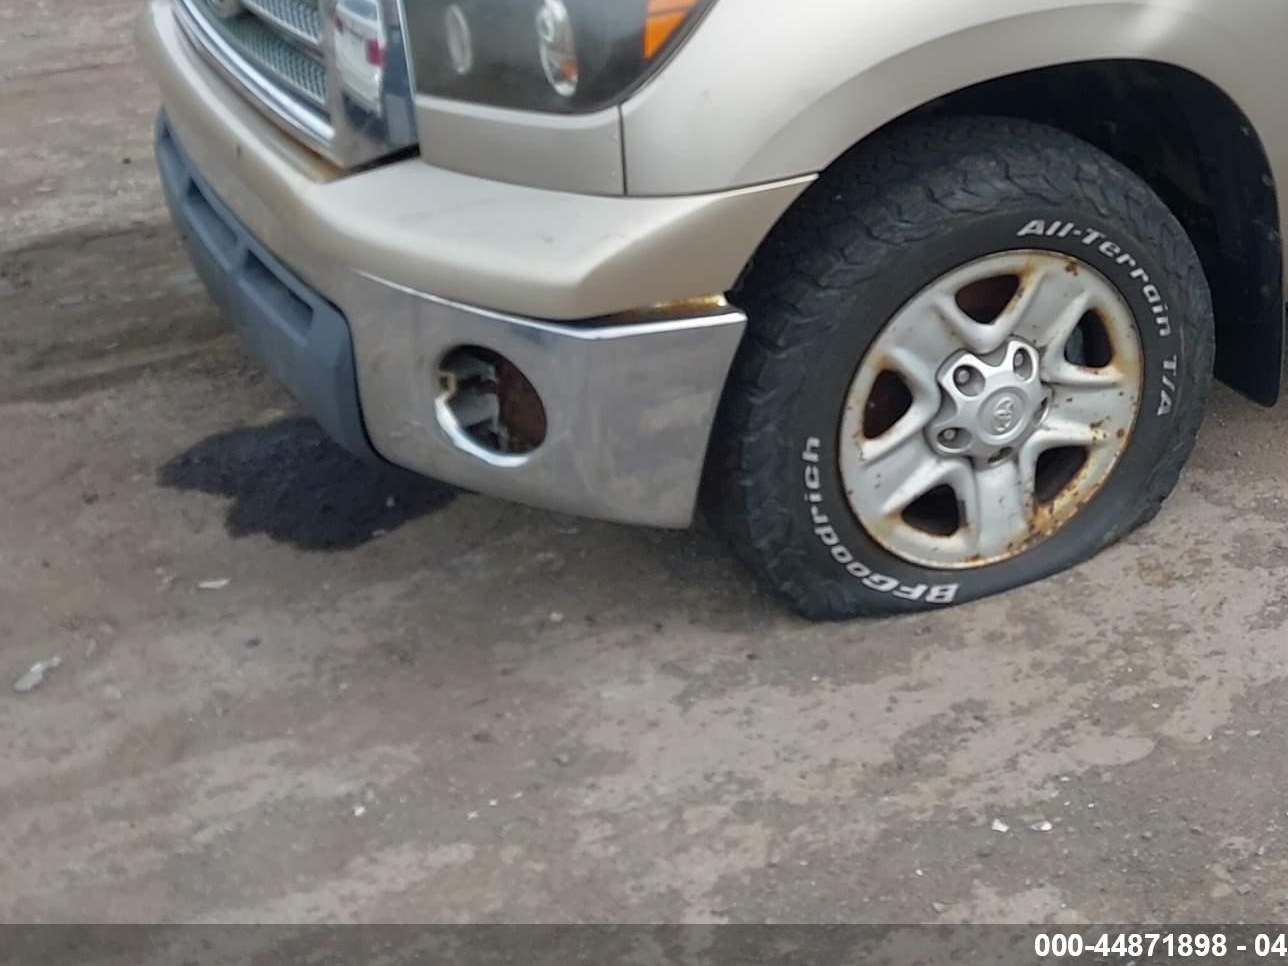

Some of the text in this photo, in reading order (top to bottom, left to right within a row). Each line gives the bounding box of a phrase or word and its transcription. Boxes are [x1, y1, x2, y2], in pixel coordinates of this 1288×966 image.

[1017, 219, 1177, 416] All-Terrain T/A
[802, 436, 959, 604] BFGoodrich
